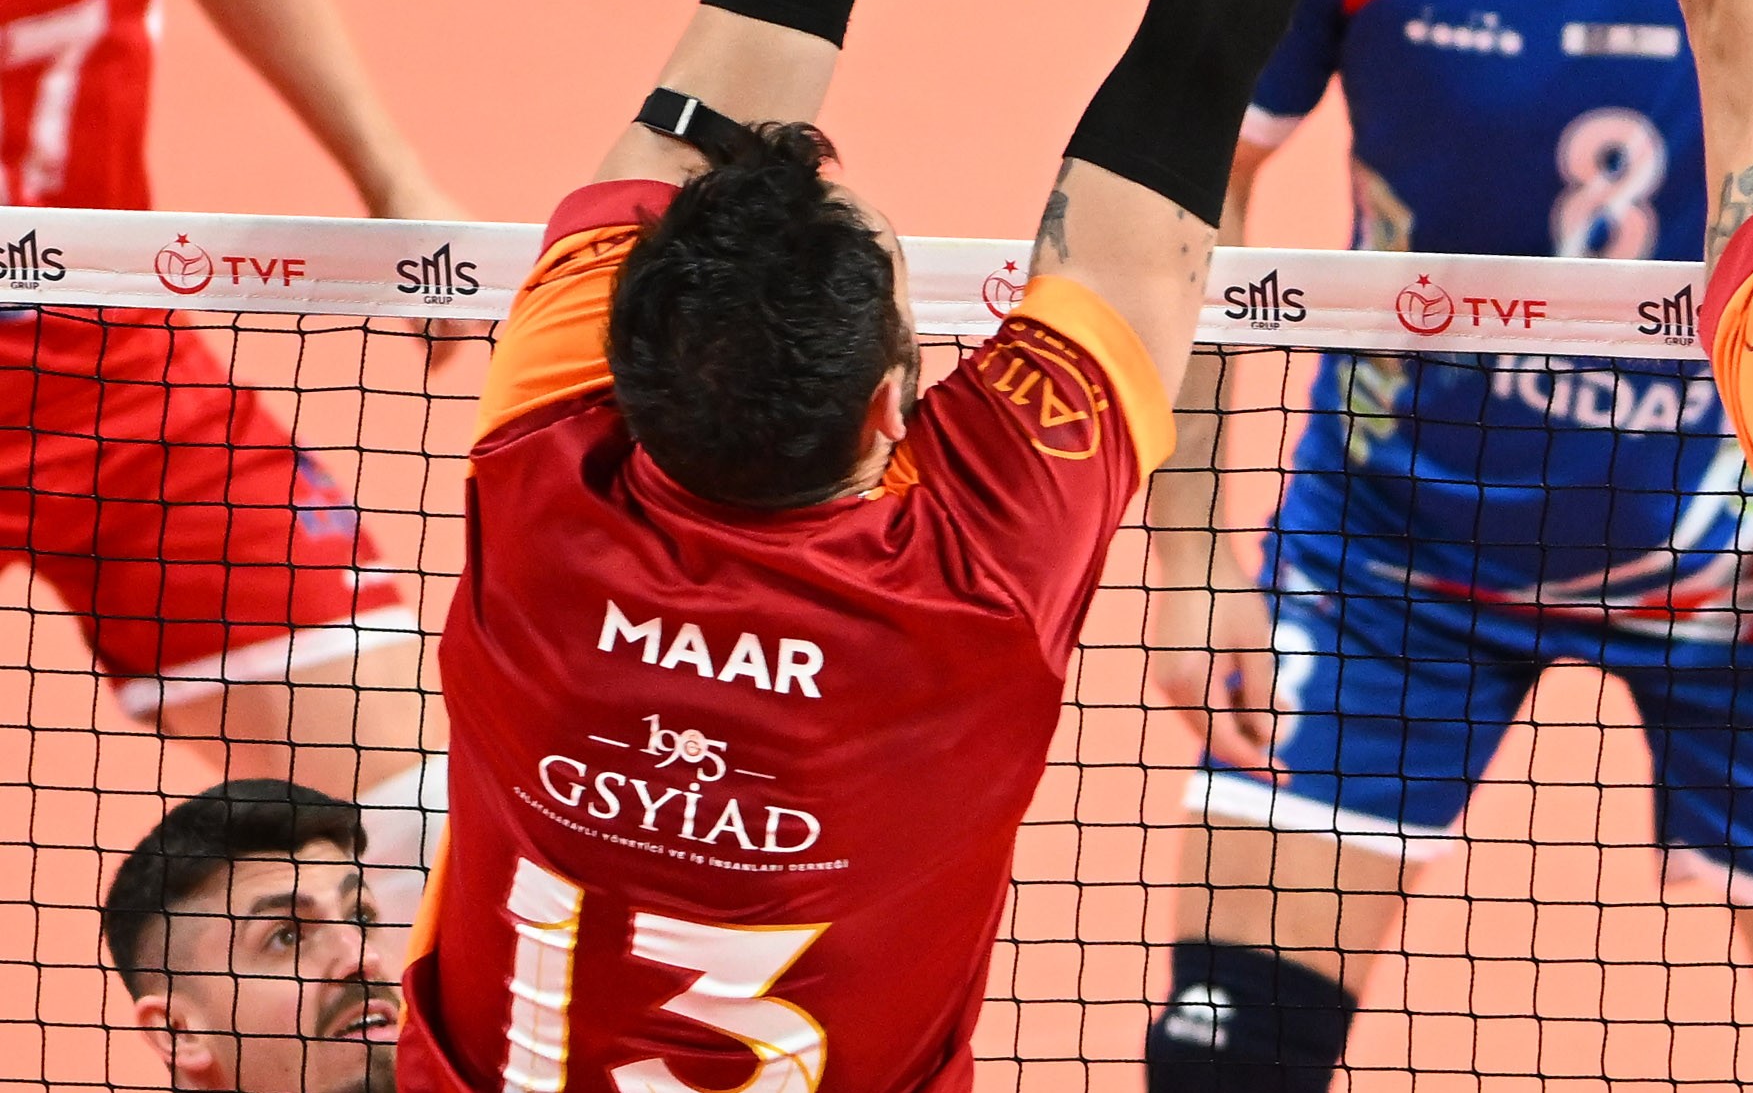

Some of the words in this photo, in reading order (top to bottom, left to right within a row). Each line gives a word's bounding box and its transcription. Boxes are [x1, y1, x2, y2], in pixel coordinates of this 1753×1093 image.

[1548, 107, 1670, 259] 8
[10, 281, 40, 290] GRUP
[222, 257, 306, 286] TVF
[396, 242, 480, 295] SMS
[424, 296, 453, 305] GRUP
[1224, 269, 1307, 323] SMS
[1462, 297, 1547, 329] TVF
[1638, 283, 1704, 337] SM
[1251, 321, 1280, 330] GRUP
[1665, 337, 1694, 346] GRUP
[597, 599, 824, 698] MAAR
[538, 754, 822, 853] GSYİAD
[668, 848, 686, 859] VE
[500, 856, 833, 1093] 13
